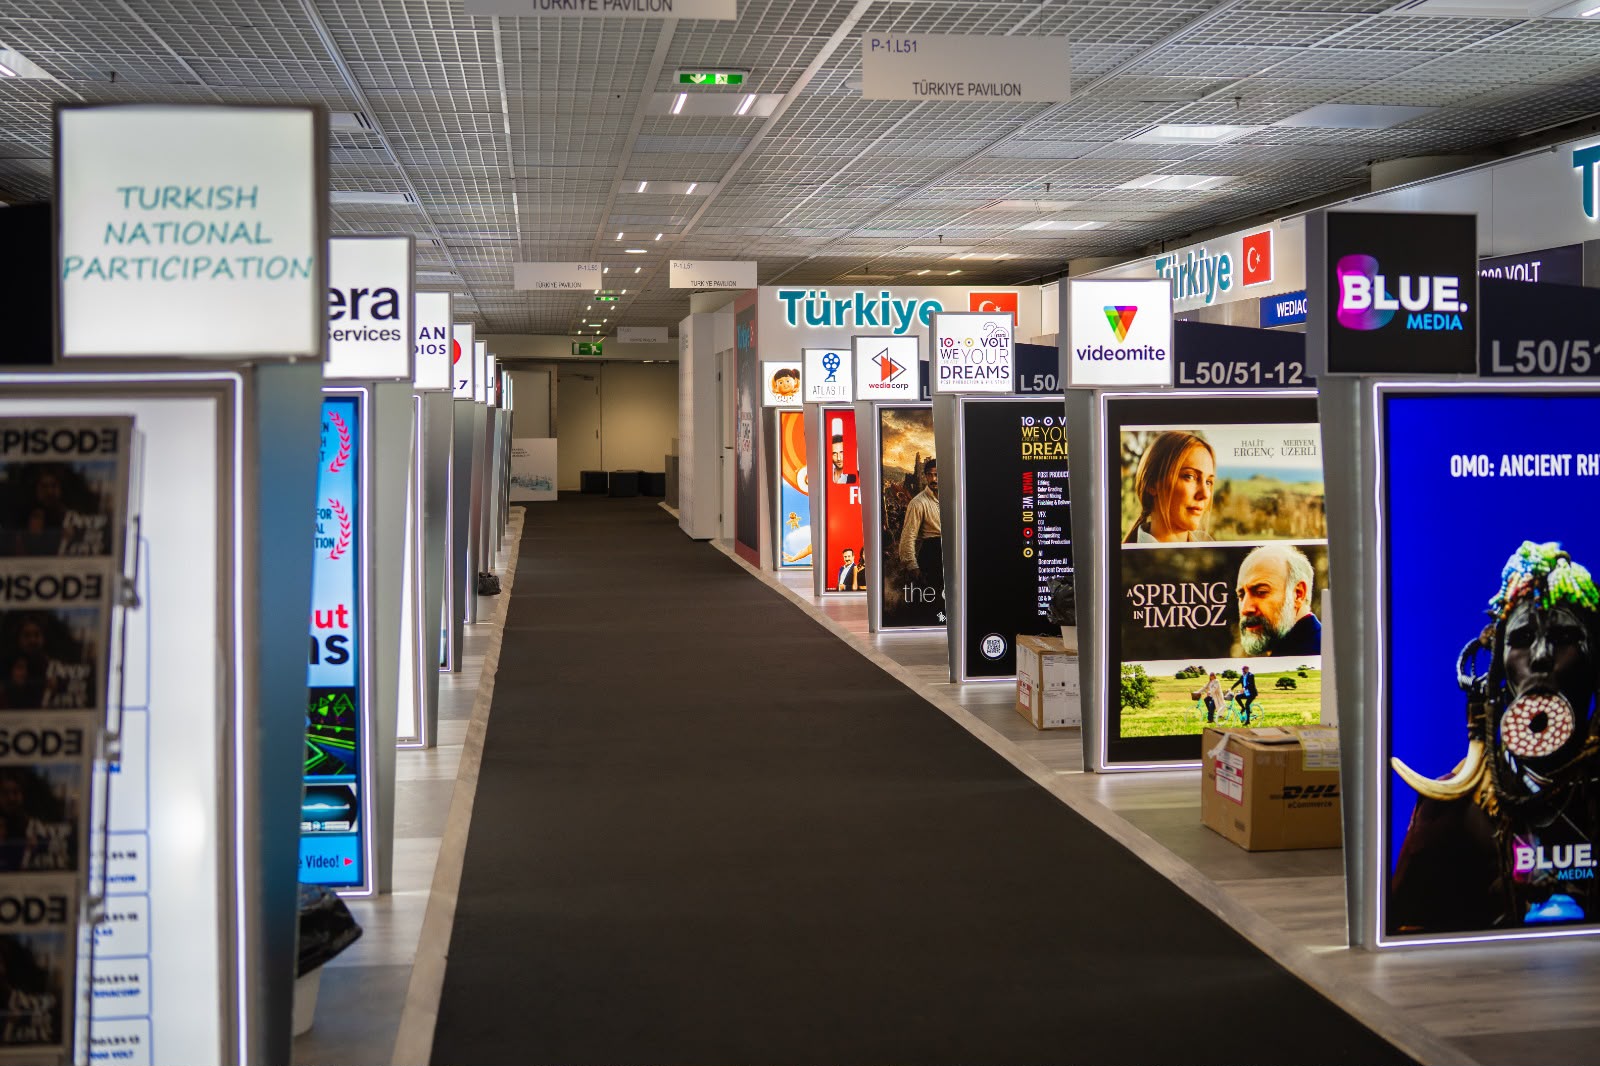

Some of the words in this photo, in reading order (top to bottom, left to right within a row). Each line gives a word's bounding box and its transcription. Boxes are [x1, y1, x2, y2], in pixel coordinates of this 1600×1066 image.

[968, 82, 1021, 97] PAVILION
[117, 185, 258, 210] TURKISH
[104, 222, 272, 245] NATIONAL
[63, 255, 313, 281] PARTICIPATION
[1505, 261, 1541, 283] VOLT
[1342, 275, 1468, 312] BLUE.
[778, 290, 943, 335] Türkiye
[1407, 314, 1463, 331] MEDIA
[940, 348, 959, 360] WE
[960, 348, 1009, 364] YOUR
[1076, 345, 1166, 361] videomite
[940, 365, 1010, 379] DREAMS
[1179, 361, 1304, 386] L50/51-12
[1021, 427, 1039, 438] WE
[1450, 454, 1495, 478] OMO:
[1499, 453, 1573, 477] ANCIENT
[1023, 511, 1033, 522] DO
[902, 582, 936, 603] the
[1132, 582, 1229, 607] SPRING
[1133, 610, 1144, 621] IN
[1143, 604, 1228, 630] IMROZ
[1282, 784, 1339, 800] DHL
[305, 854, 340, 869] Video!
[1515, 843, 1598, 871] BLUE.
[1557, 868, 1595, 881] MEDIA
